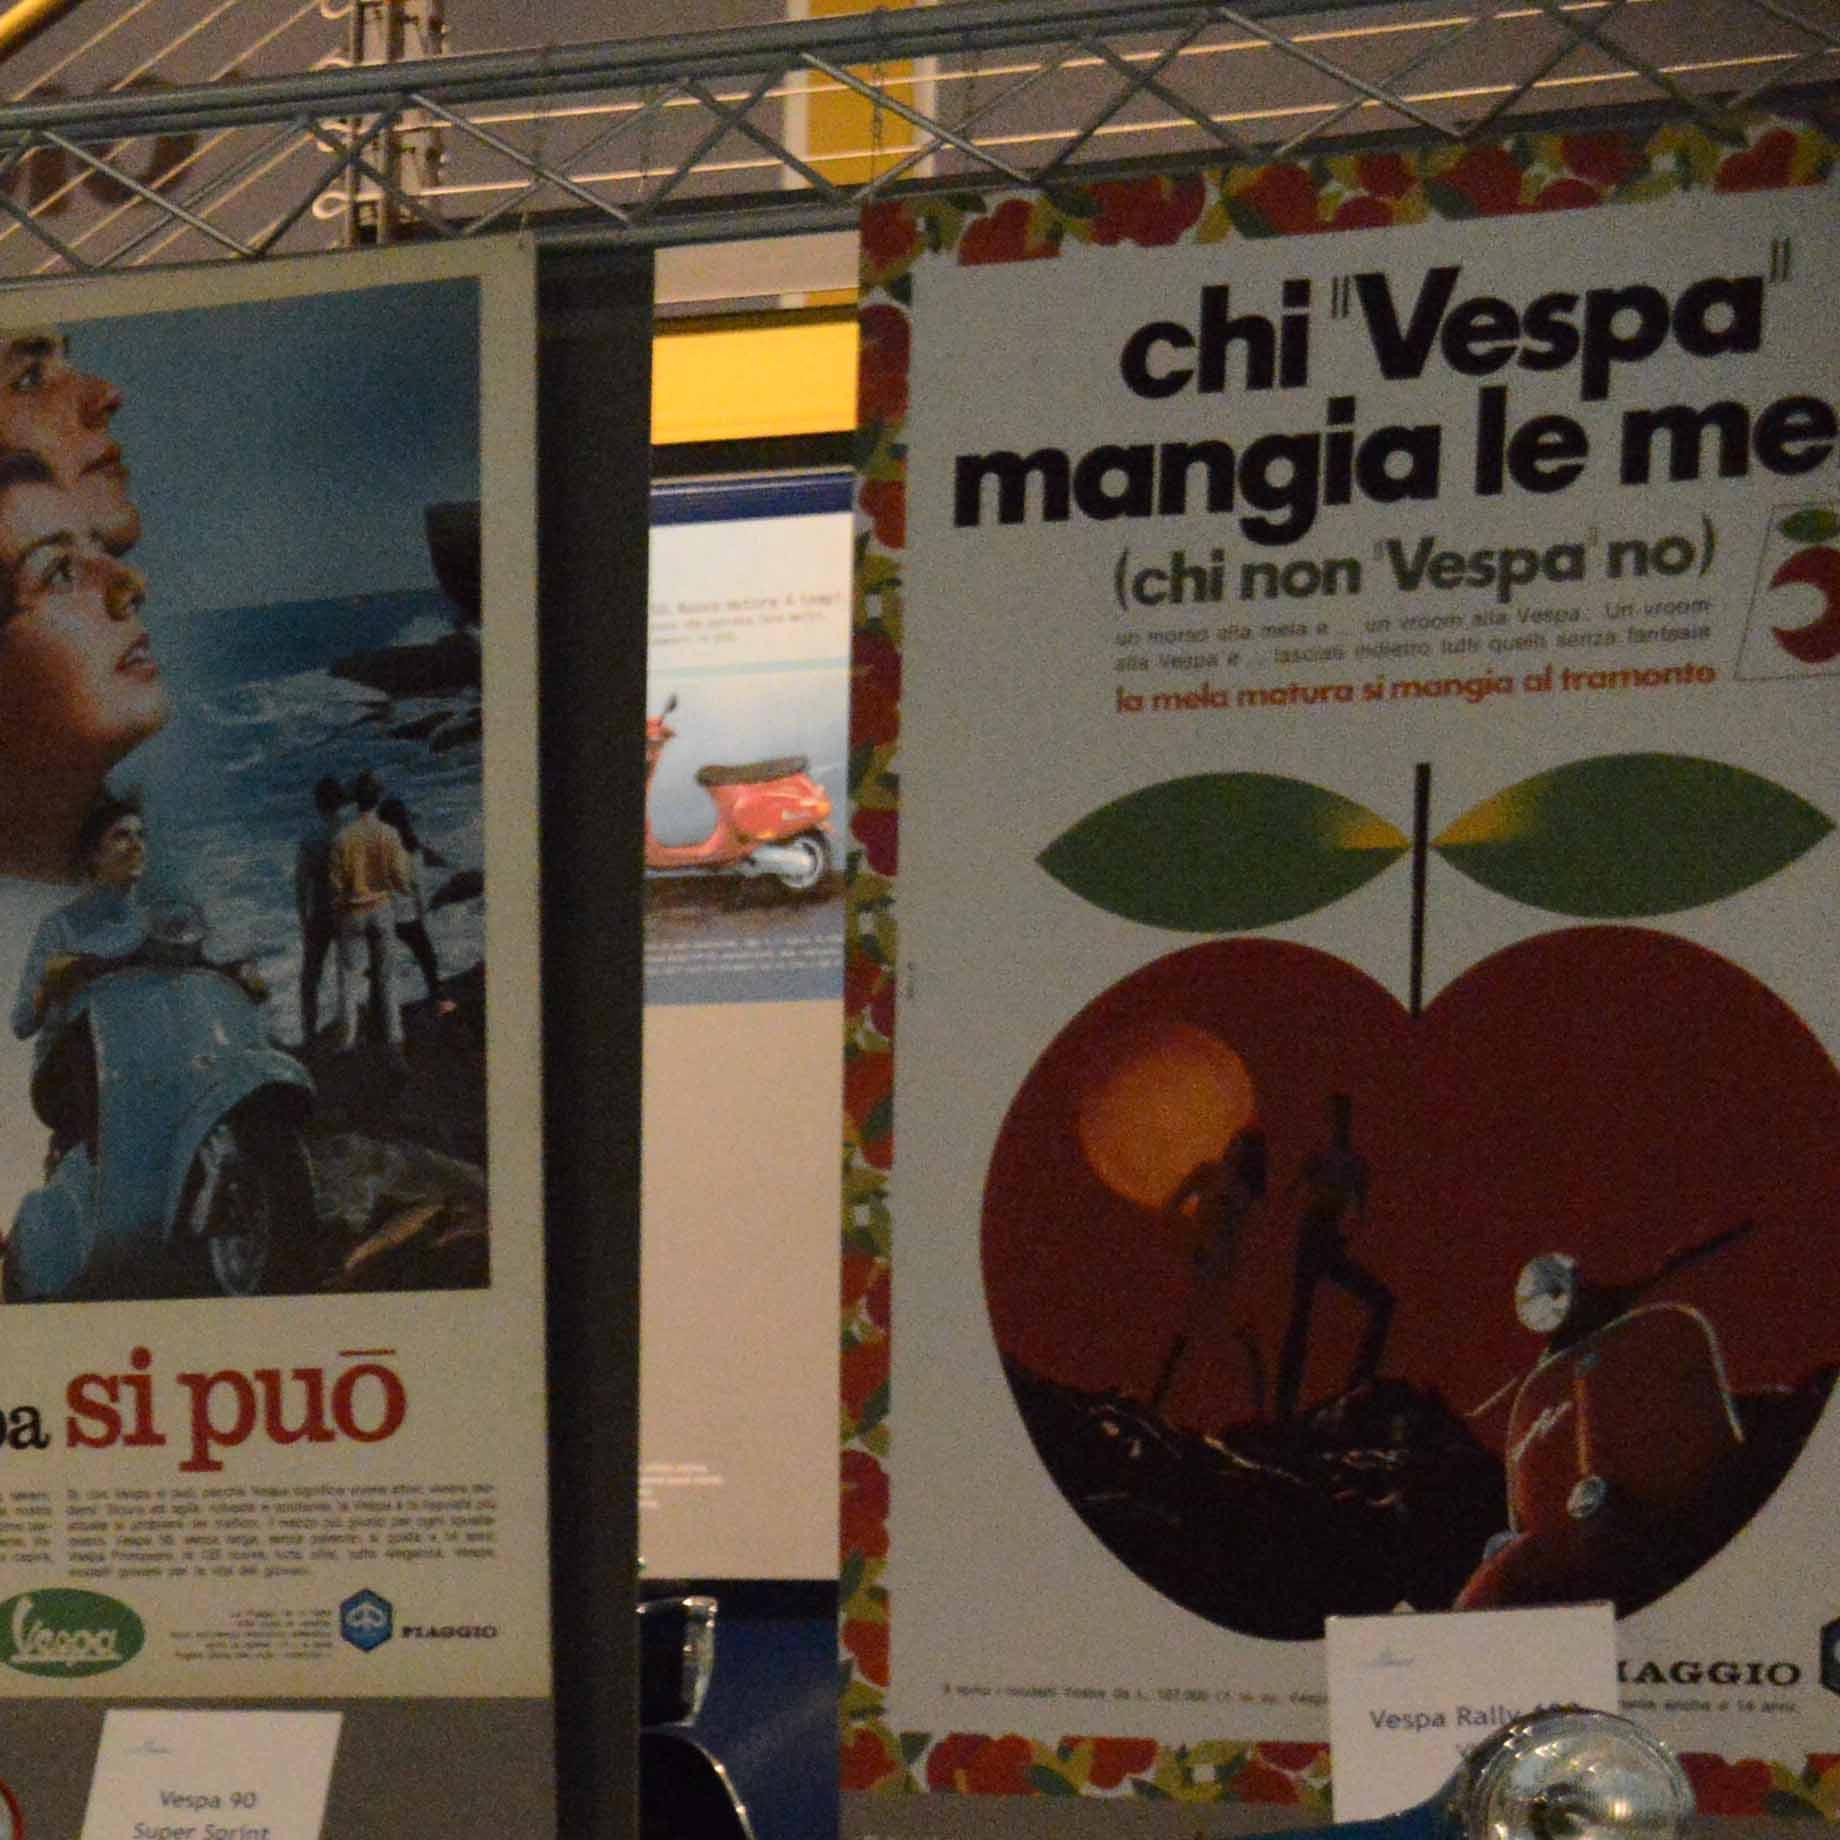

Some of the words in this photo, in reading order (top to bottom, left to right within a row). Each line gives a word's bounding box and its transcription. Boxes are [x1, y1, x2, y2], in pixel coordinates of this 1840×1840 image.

[1121, 278, 1311, 398] chi
[954, 397, 1440, 545] mangia
[1476, 386, 1589, 495] le
[1621, 395, 1839, 486] me
[1113, 548, 1224, 613] (chi
[1240, 553, 1362, 600] non
[1607, 513, 1716, 577] no)
[1116, 686, 1143, 714] la
[1152, 682, 1230, 712] mela
[1237, 683, 1354, 707] matura
[1362, 678, 1385, 702] si
[1391, 672, 1514, 703] mangia
[1523, 666, 1553, 693] al
[1561, 662, 1716, 691] tramonto
[65, 1346, 166, 1449] si
[8, 1596, 119, 1667] Vespa
[400, 1626, 498, 1641] PIAGGIO
[1617, 1660, 1801, 1686] IAGGIO
[1370, 1708, 1447, 1731] Vespa
[160, 1790, 222, 1812] Vespa
[230, 1791, 259, 1809] 90
